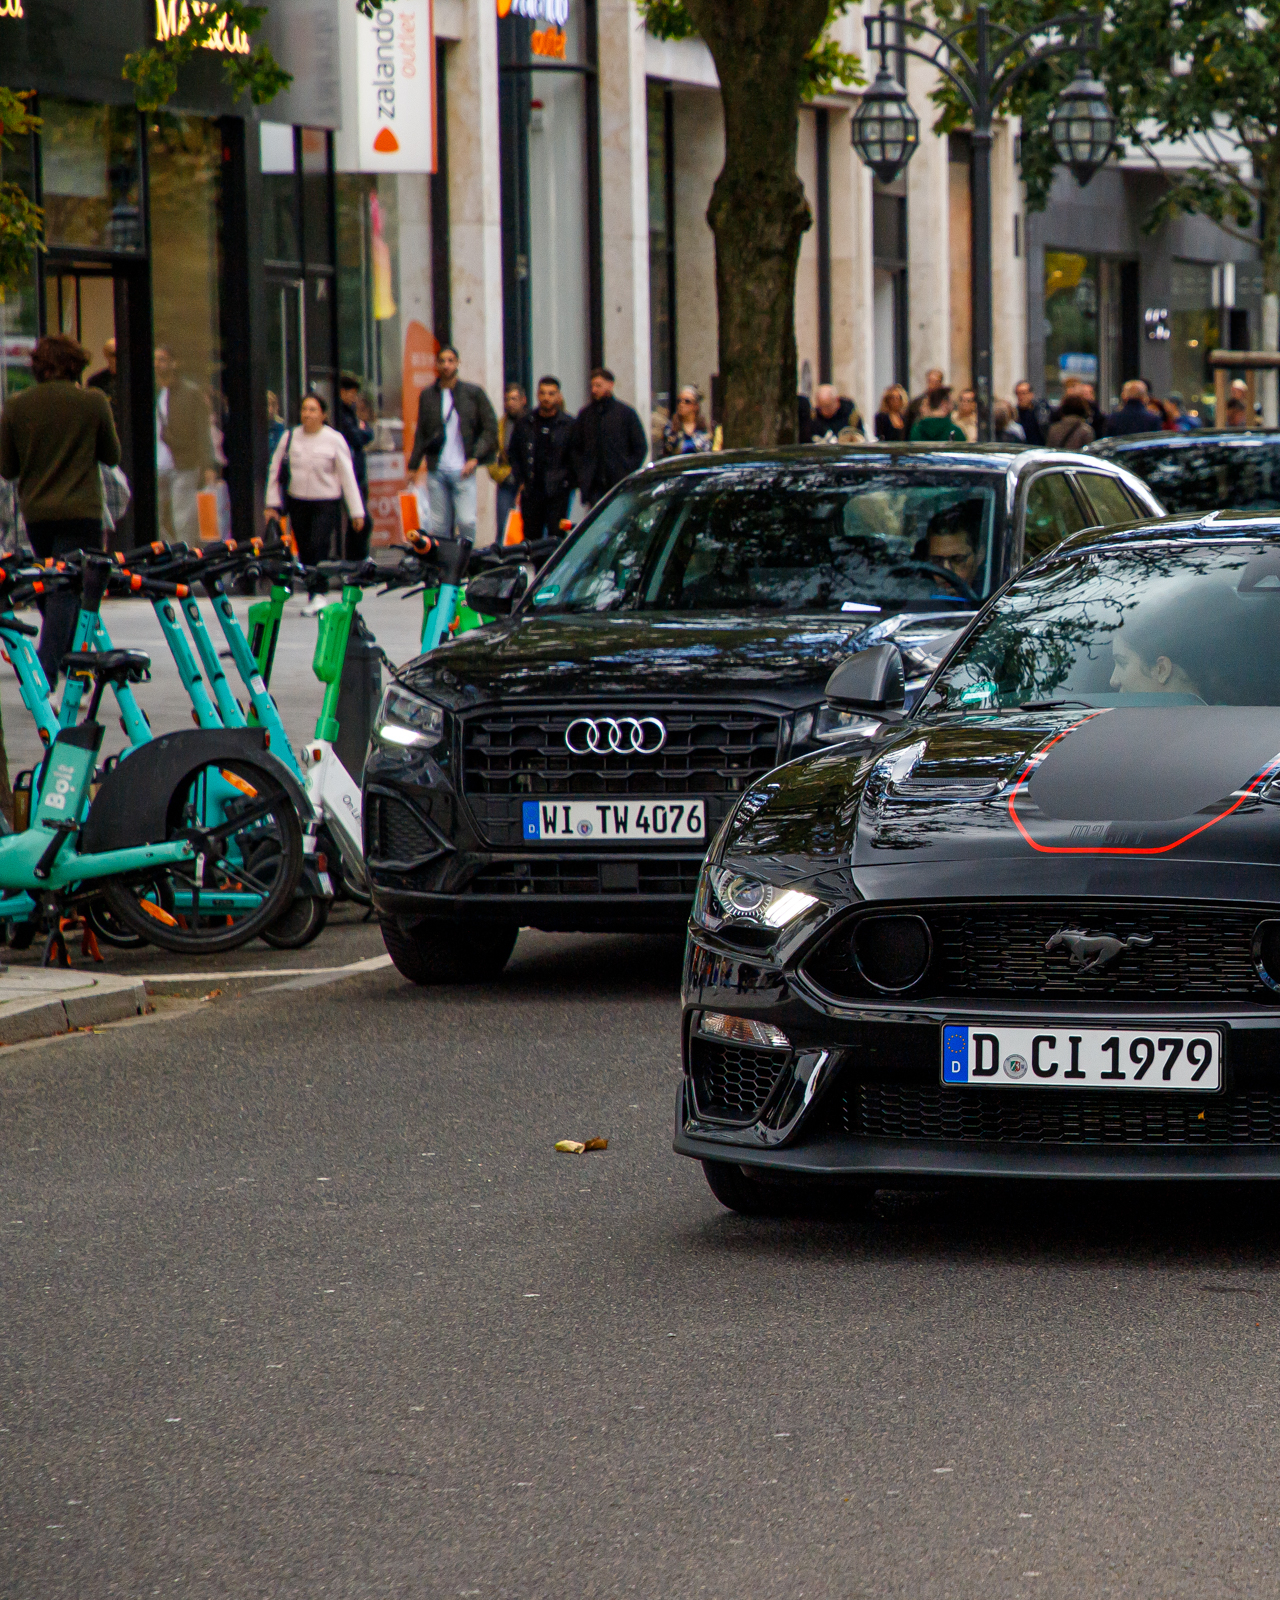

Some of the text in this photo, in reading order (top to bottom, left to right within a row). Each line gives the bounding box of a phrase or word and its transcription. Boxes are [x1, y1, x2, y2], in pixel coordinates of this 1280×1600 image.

[371, 8, 395, 119] zalando
[398, 11, 416, 79] outlet
[44, 764, 75, 810] Bolt
[528, 823, 536, 834] D
[542, 804, 702, 834] WI TW 4076
[951, 1060, 961, 1073] D
[972, 1033, 1213, 1081] D CI 1979
